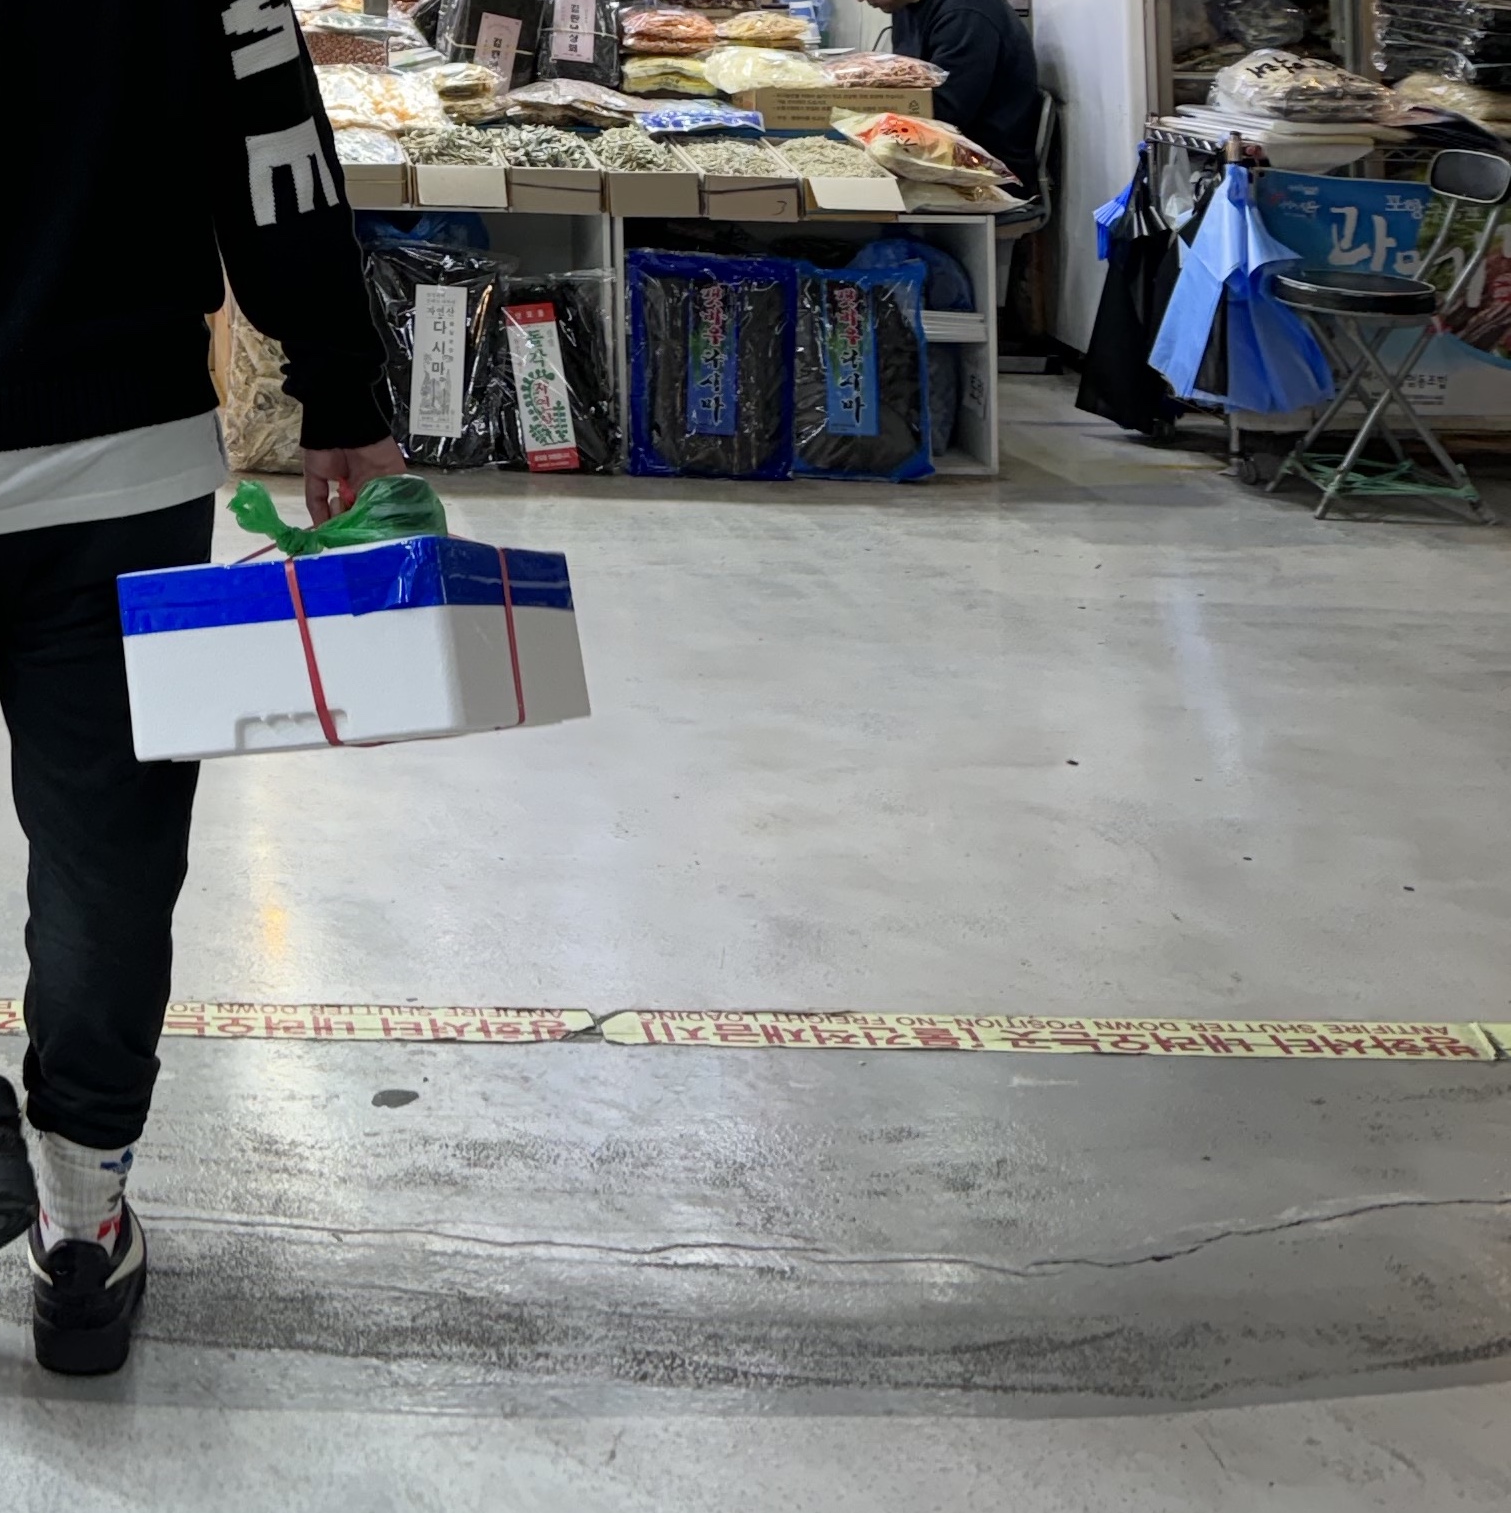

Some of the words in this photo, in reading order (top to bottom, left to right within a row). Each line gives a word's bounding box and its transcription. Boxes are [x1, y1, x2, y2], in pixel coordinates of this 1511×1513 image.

[431, 320, 447, 375] 다시마
[698, 348, 727, 426] 다시마
[839, 348, 867, 426] 다시마
[216, 1003, 297, 1016] DOWN
[771, 1010, 885, 1028] FREIGHT
[1093, 1018, 1181, 1033] DOWN
[1189, 1020, 1316, 1035] SHUTTER
[1320, 1022, 1449, 1037] ANTIFIRE
[1281, 1035, 1477, 1060] 방화셔터
